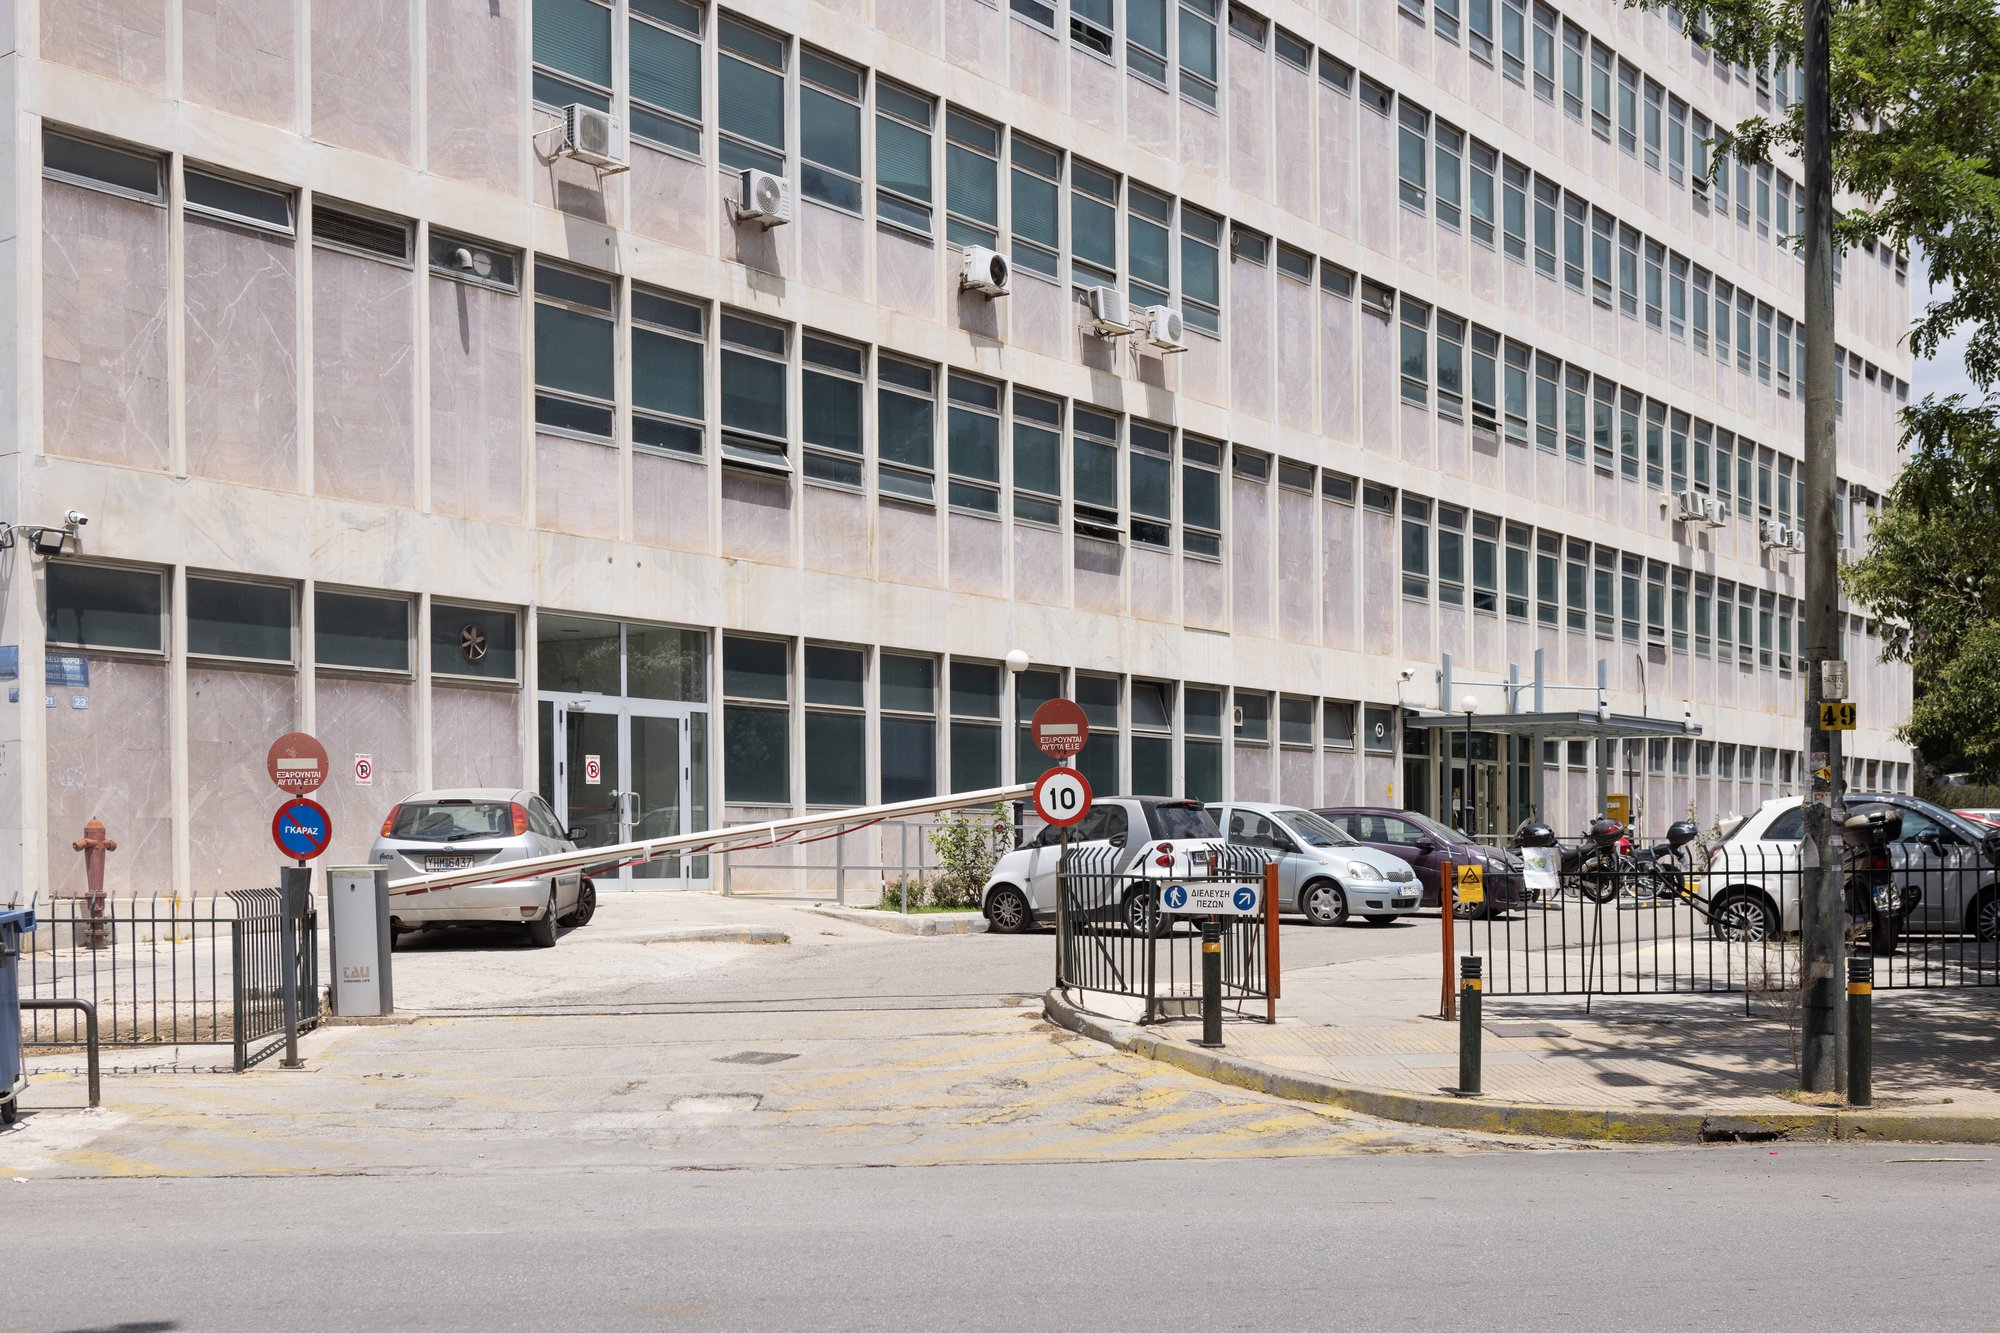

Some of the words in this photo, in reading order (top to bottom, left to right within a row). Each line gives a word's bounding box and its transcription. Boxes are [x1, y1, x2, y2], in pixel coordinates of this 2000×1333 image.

[75, 698, 86, 706] 23
[1822, 705, 1856, 726] 49
[1049, 787, 1076, 810] 10
[284, 825, 319, 835] ΓΚΑΡΑΖ
[1191, 889, 1230, 898] ΔΙΕΛΕΥΣΗ
[1196, 900, 1224, 908] ΠΕΖΩΝ
